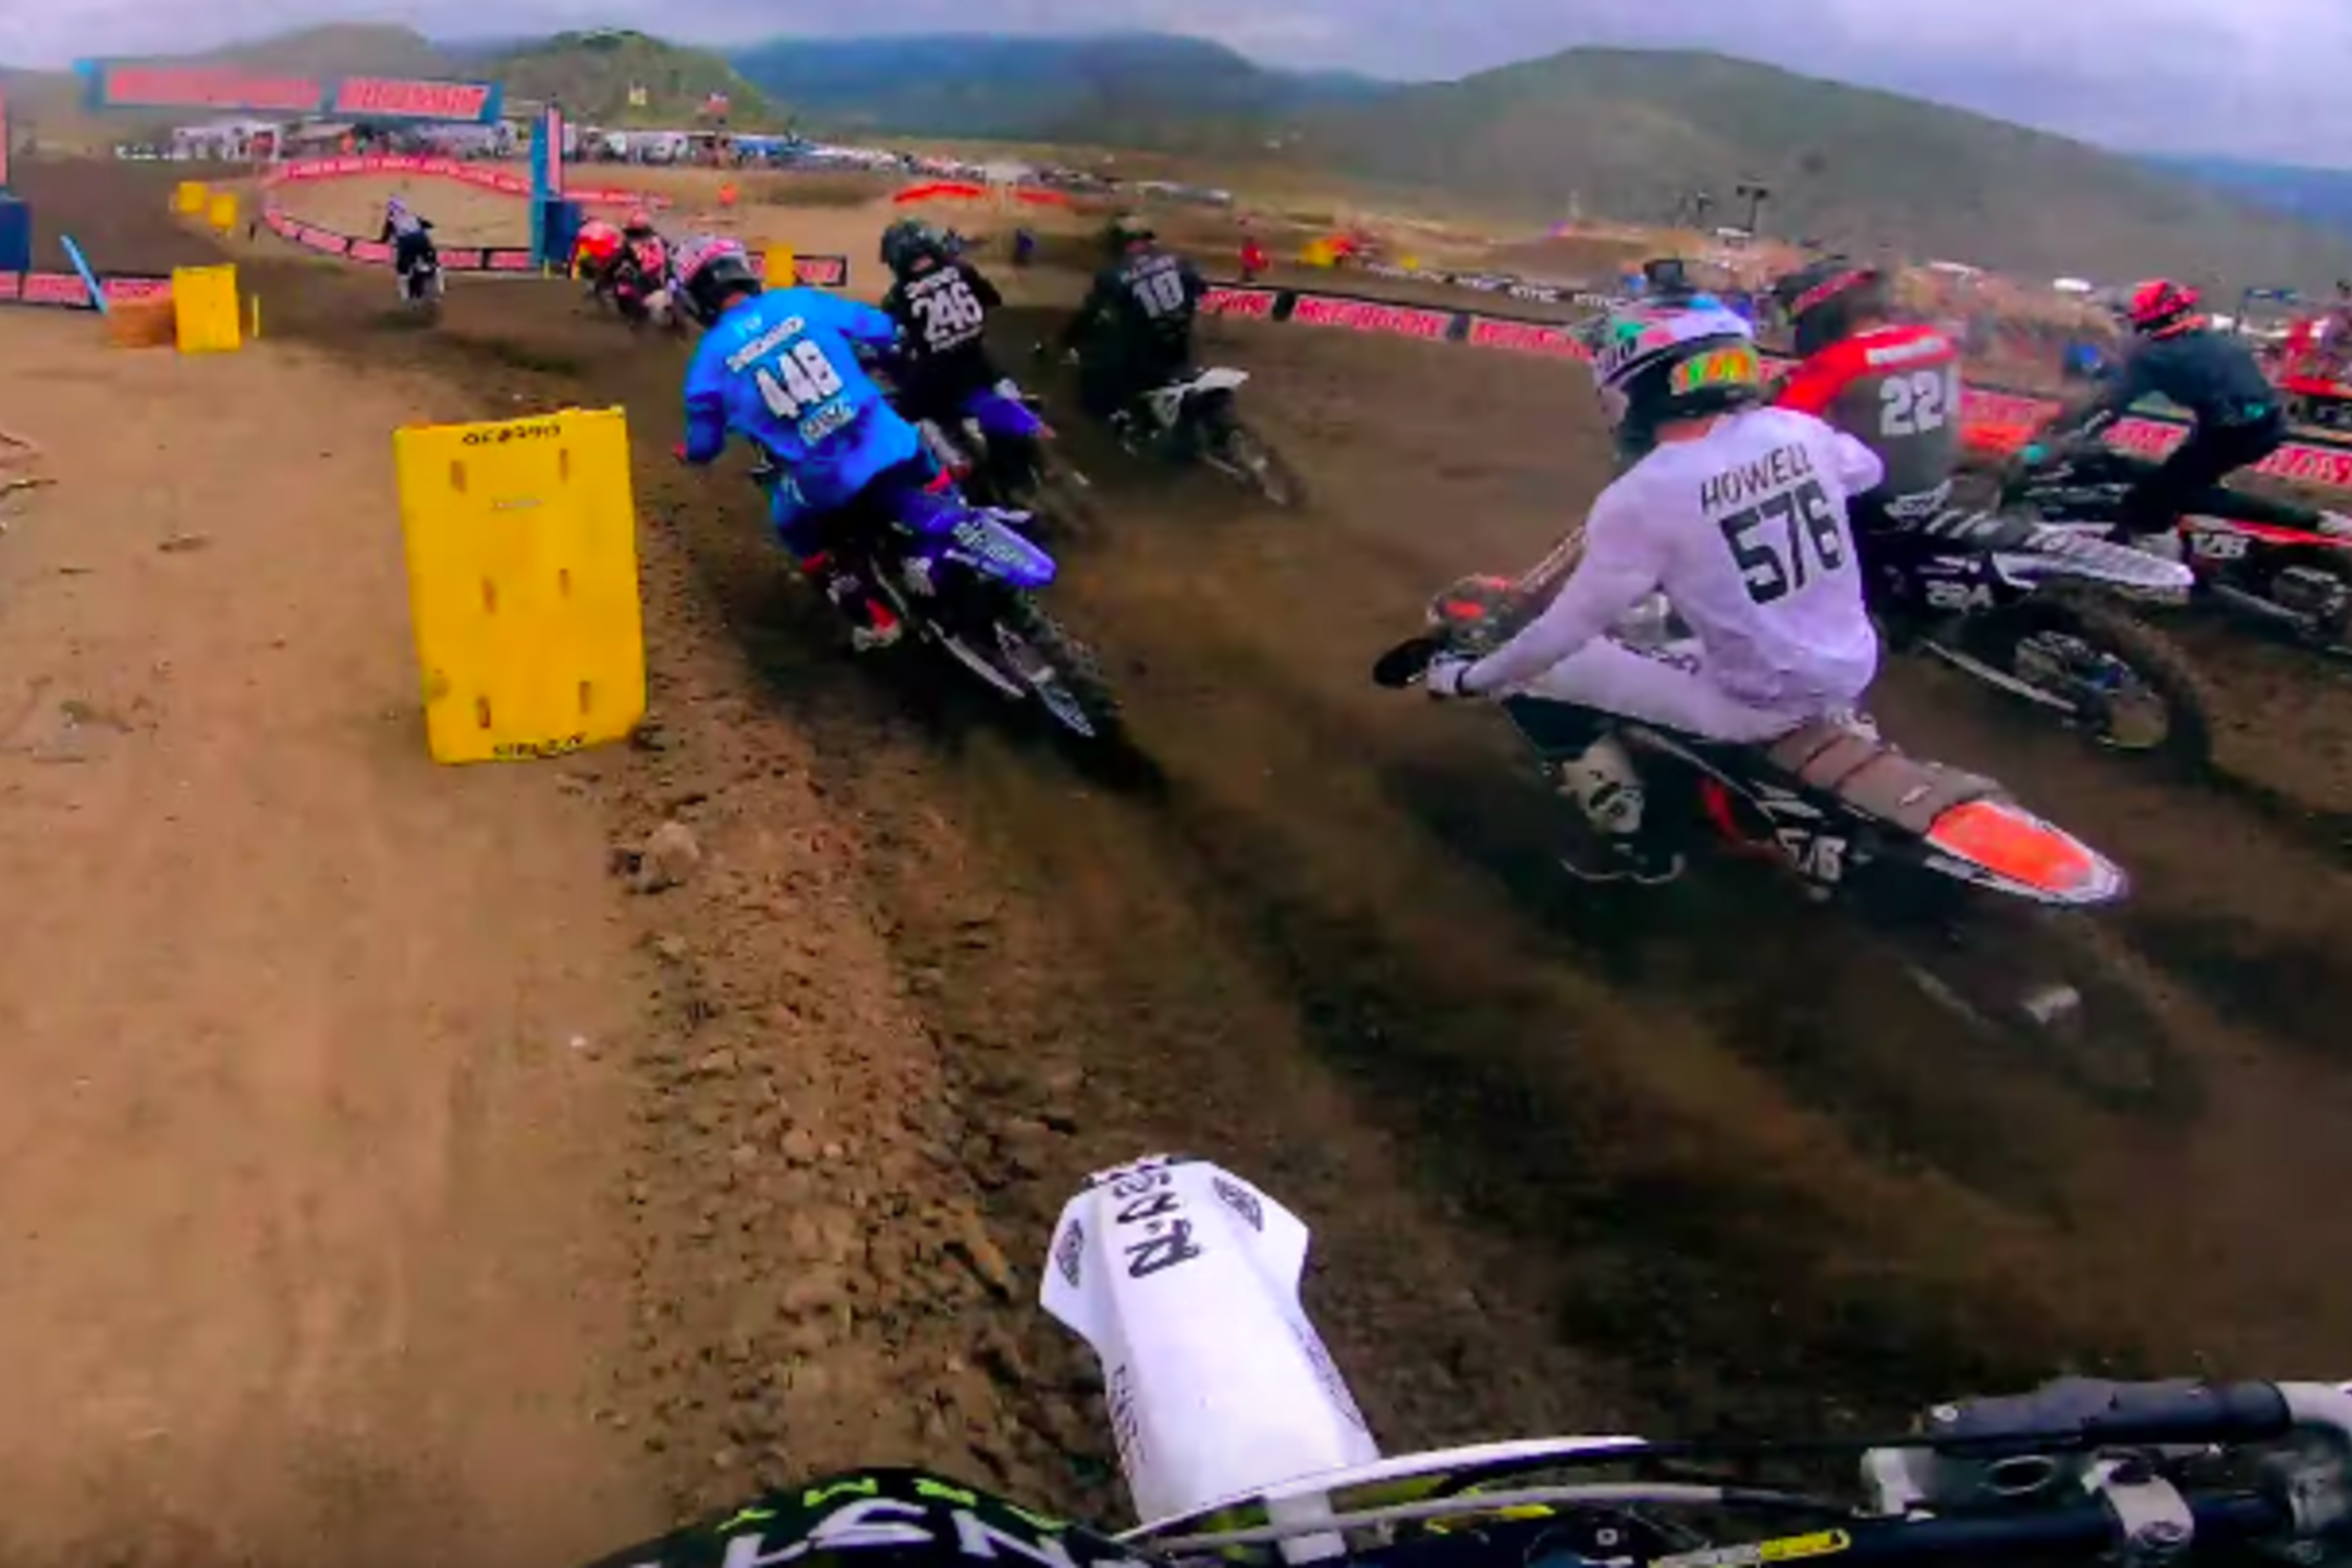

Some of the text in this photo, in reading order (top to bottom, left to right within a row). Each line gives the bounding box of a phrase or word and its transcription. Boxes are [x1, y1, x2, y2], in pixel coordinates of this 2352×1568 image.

[911, 282, 982, 342] 246
[756, 340, 843, 418] 448
[1701, 442, 1813, 515] HOWELL
[1720, 478, 1843, 606] 576
